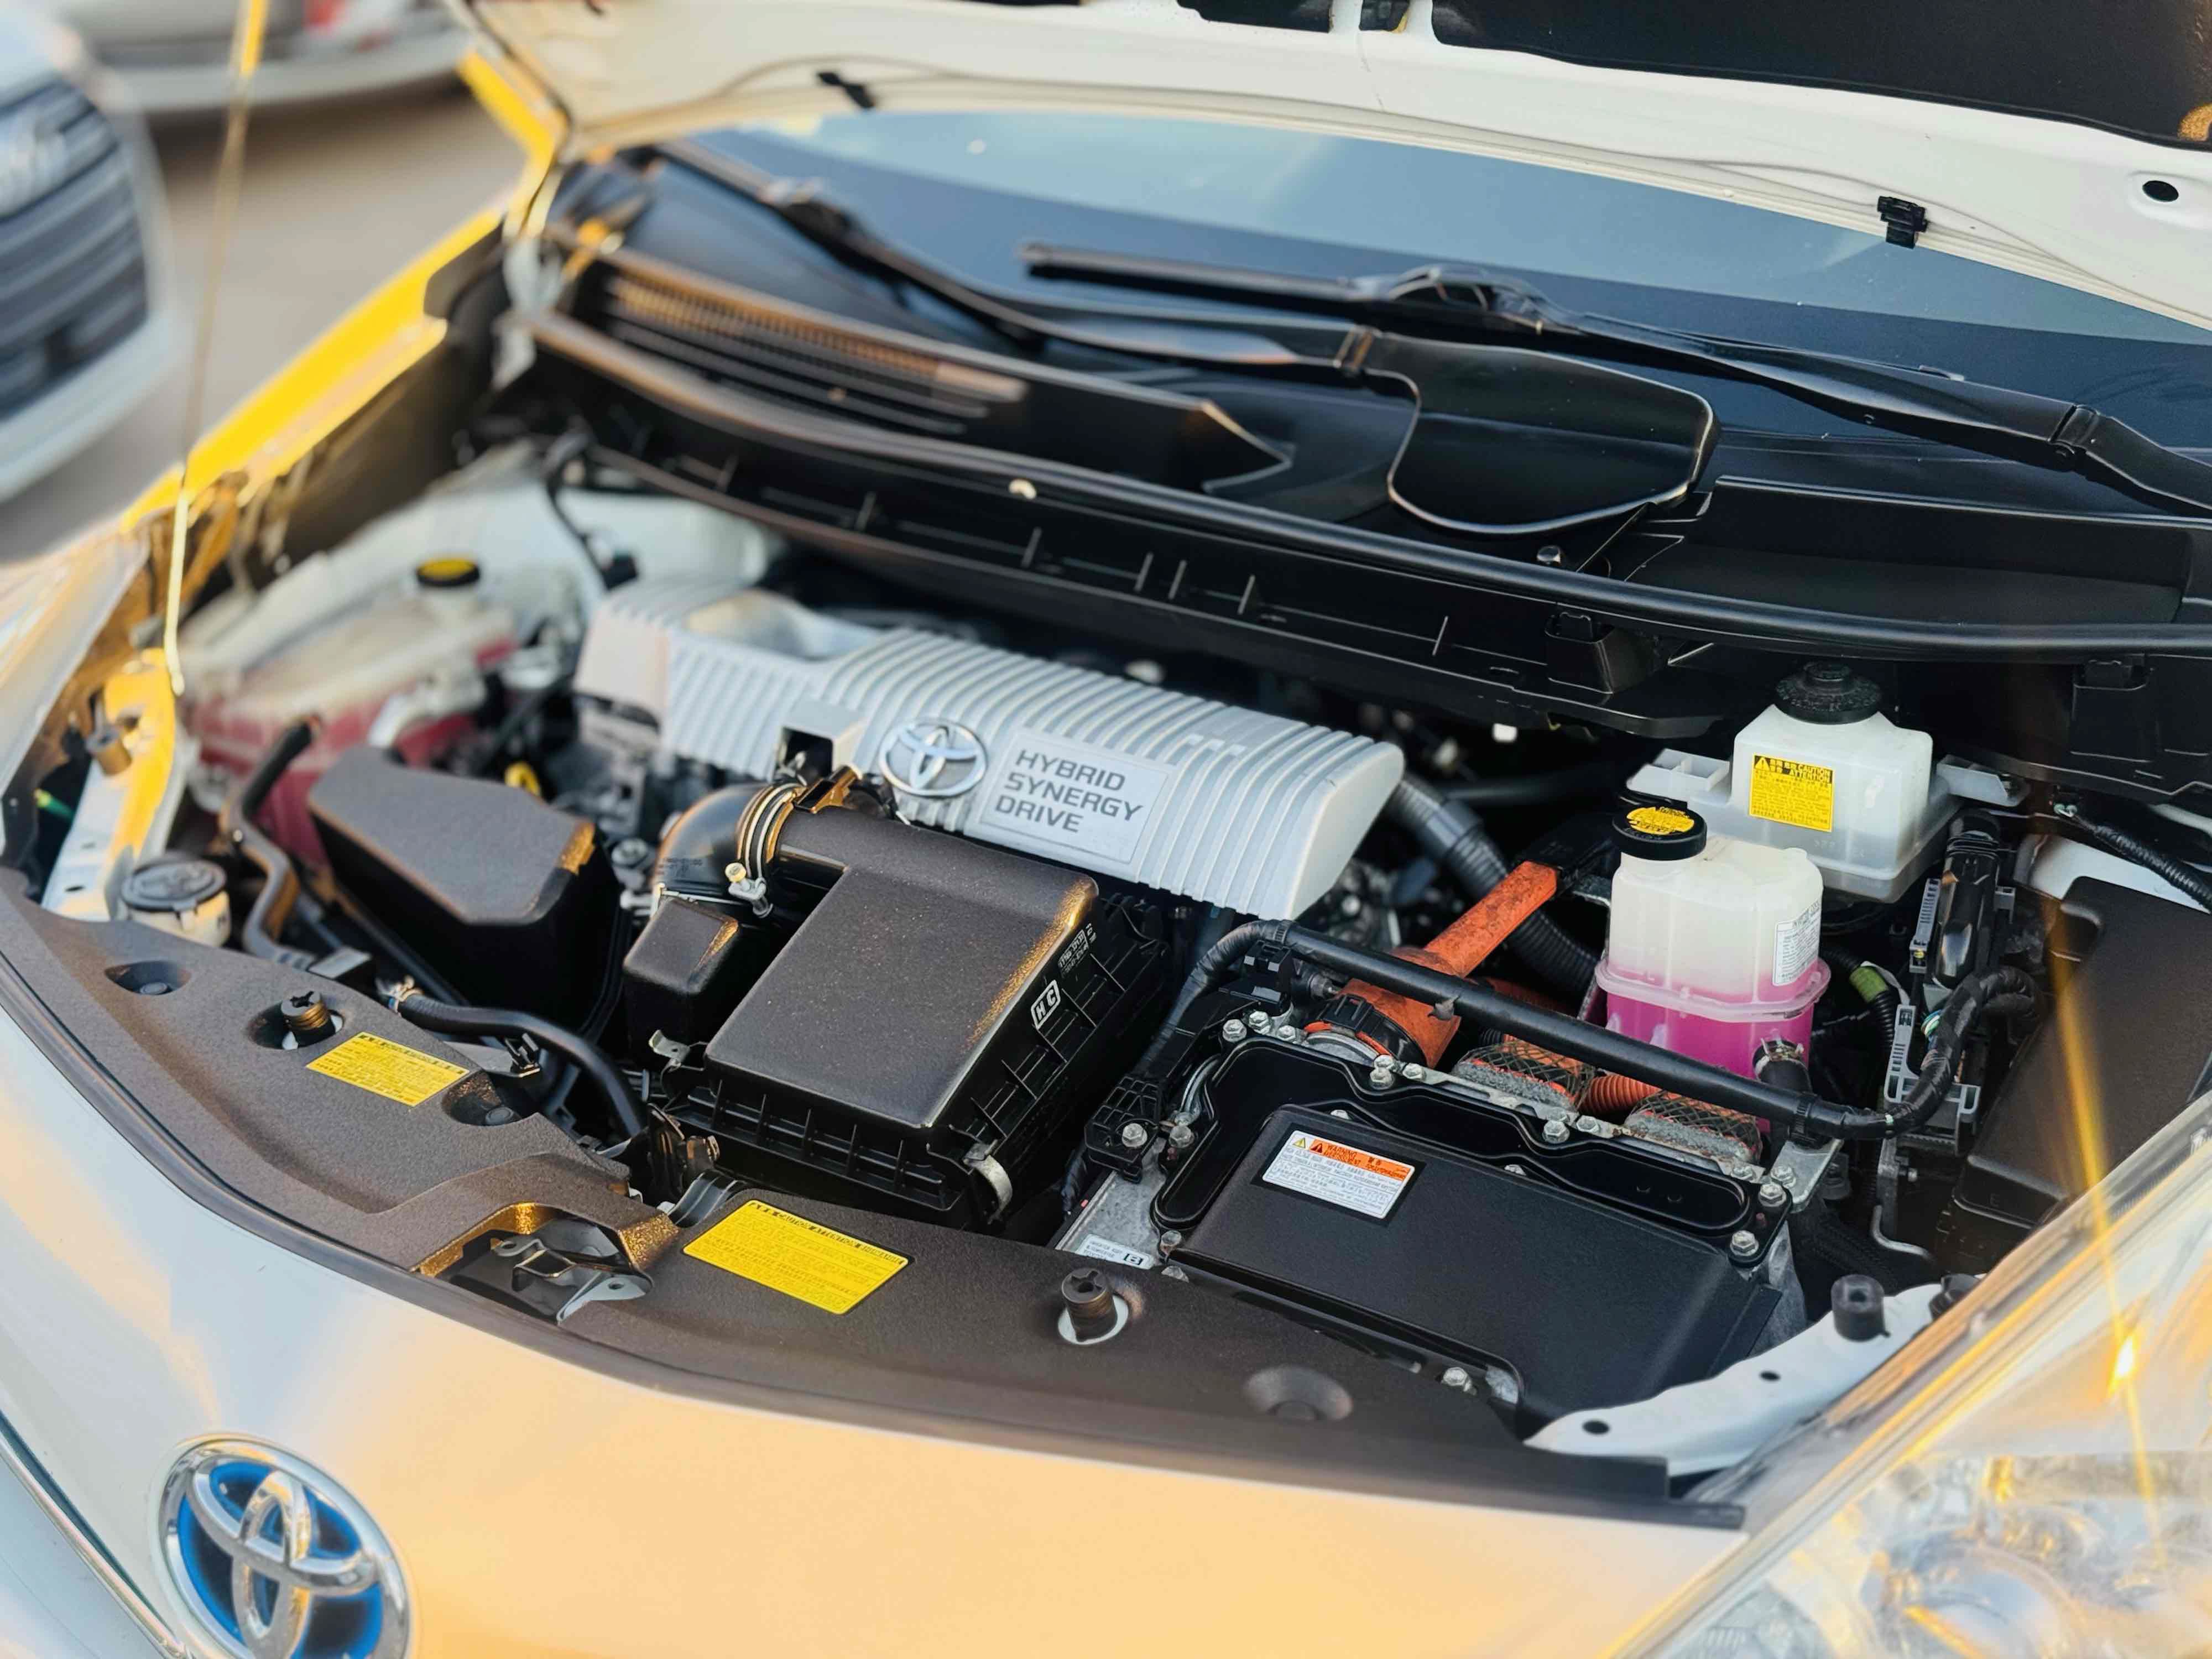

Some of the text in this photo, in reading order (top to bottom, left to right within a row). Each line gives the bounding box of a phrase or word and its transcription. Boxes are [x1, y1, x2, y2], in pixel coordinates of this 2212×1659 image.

[1015, 749, 1126, 791] HYBRID
[1798, 764, 1830, 777] CAUTION
[995, 795, 1084, 833] DRIVE
[1004, 772, 1144, 821] SYNERGY
[1036, 988, 1057, 1021] HC
